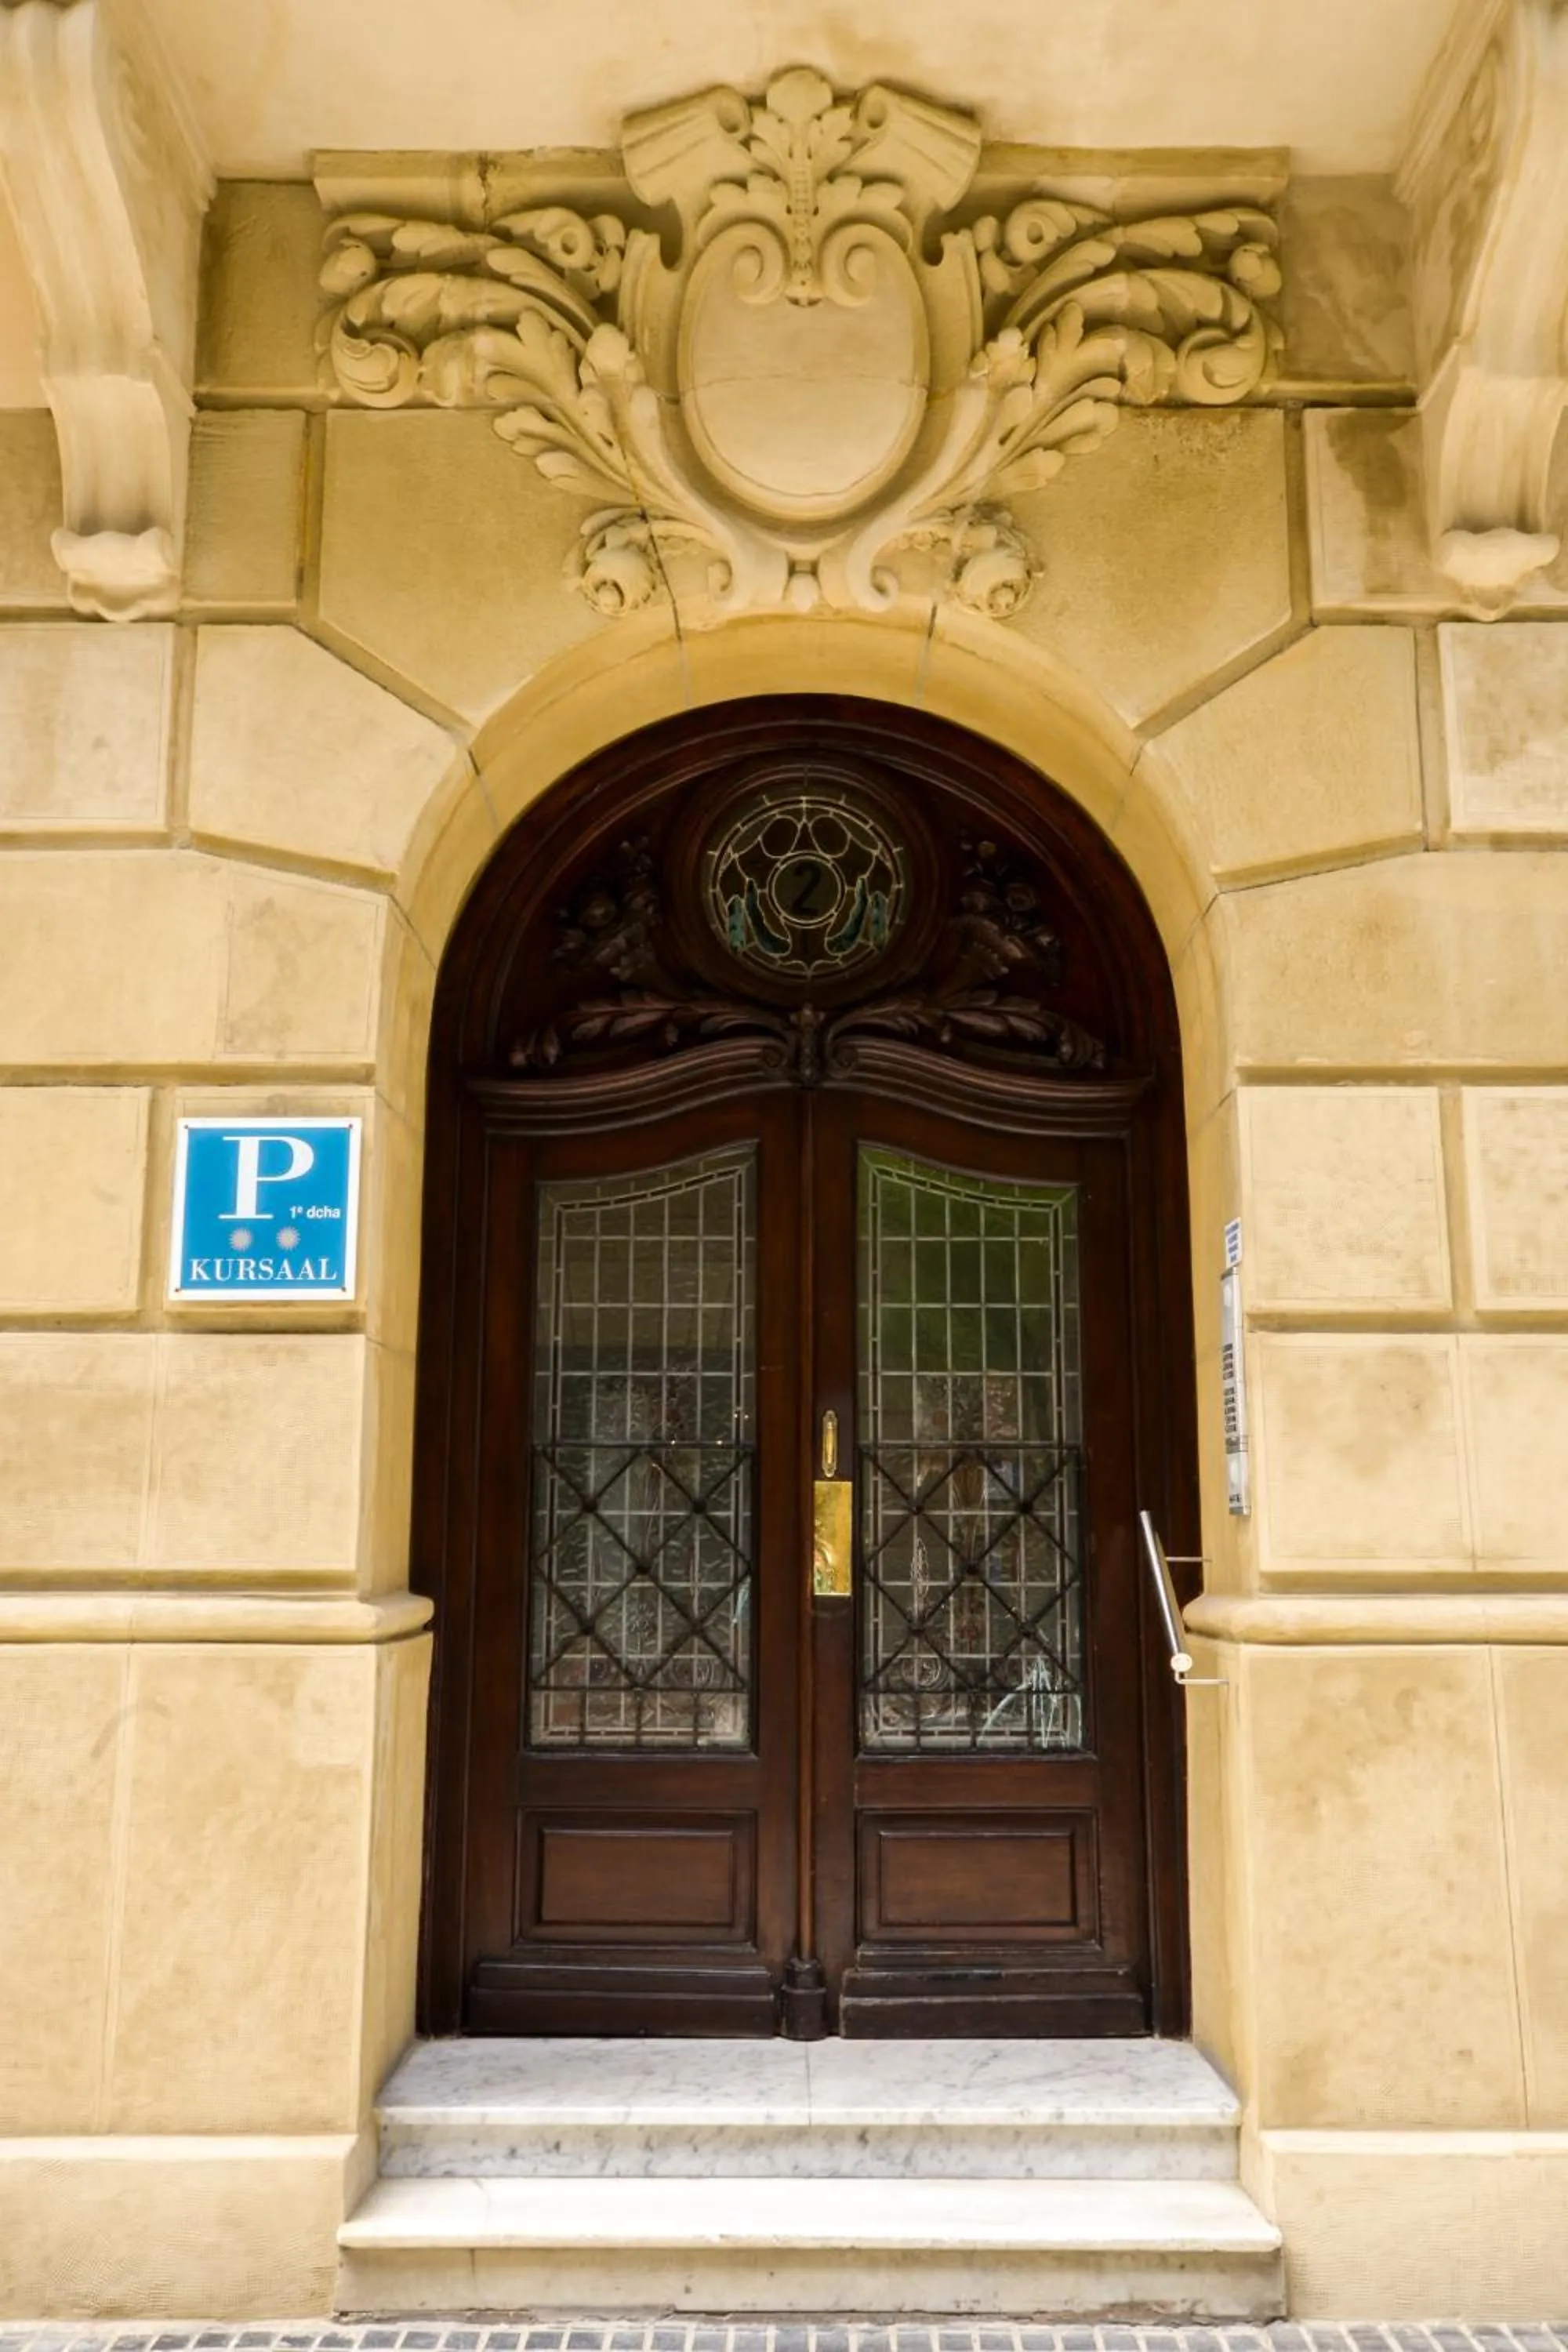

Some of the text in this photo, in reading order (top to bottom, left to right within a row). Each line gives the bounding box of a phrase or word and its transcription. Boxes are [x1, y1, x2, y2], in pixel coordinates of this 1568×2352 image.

[792, 863, 822, 915] 2
[218, 1136, 314, 1219] P
[307, 1206, 341, 1219] dcha
[189, 1258, 337, 1281] KURSAAL
